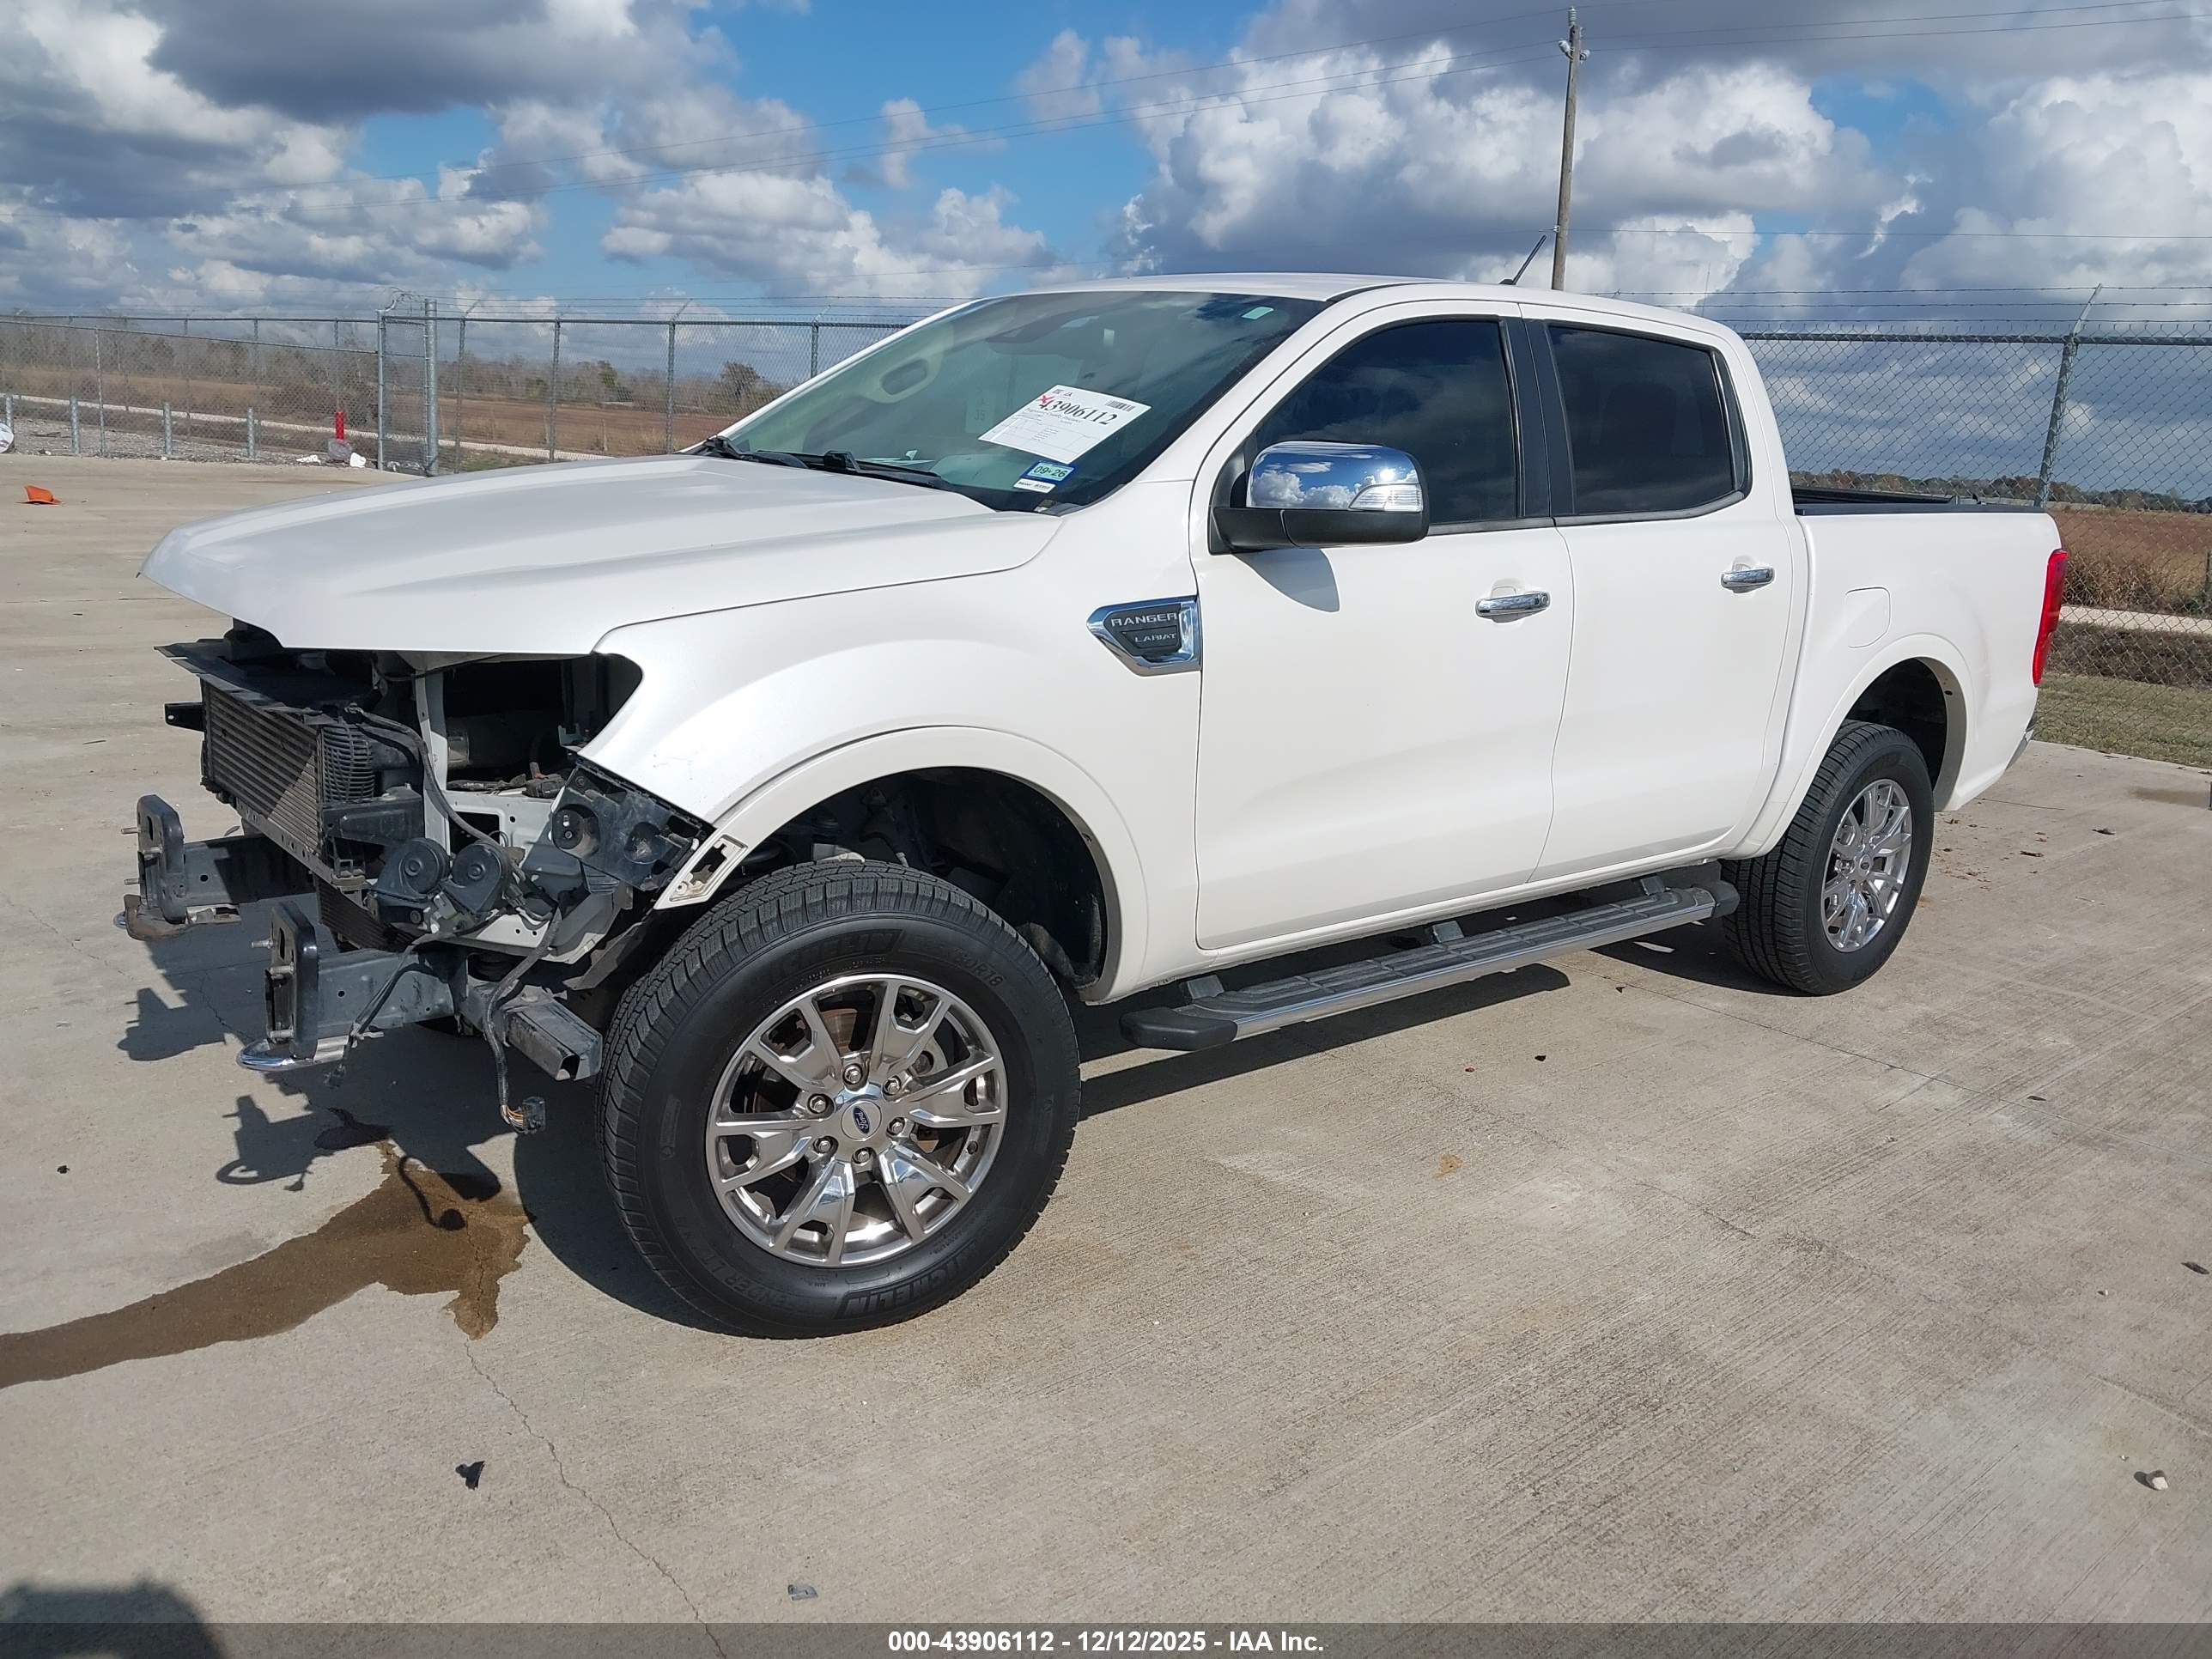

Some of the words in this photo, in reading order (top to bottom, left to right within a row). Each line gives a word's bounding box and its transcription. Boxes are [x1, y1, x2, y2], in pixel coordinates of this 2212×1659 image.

[1038, 398, 1118, 425] 43906112
[1110, 612, 1177, 627] RANGER
[1134, 632, 1176, 643] LARIAT
[855, 1111, 870, 1129] Ford
